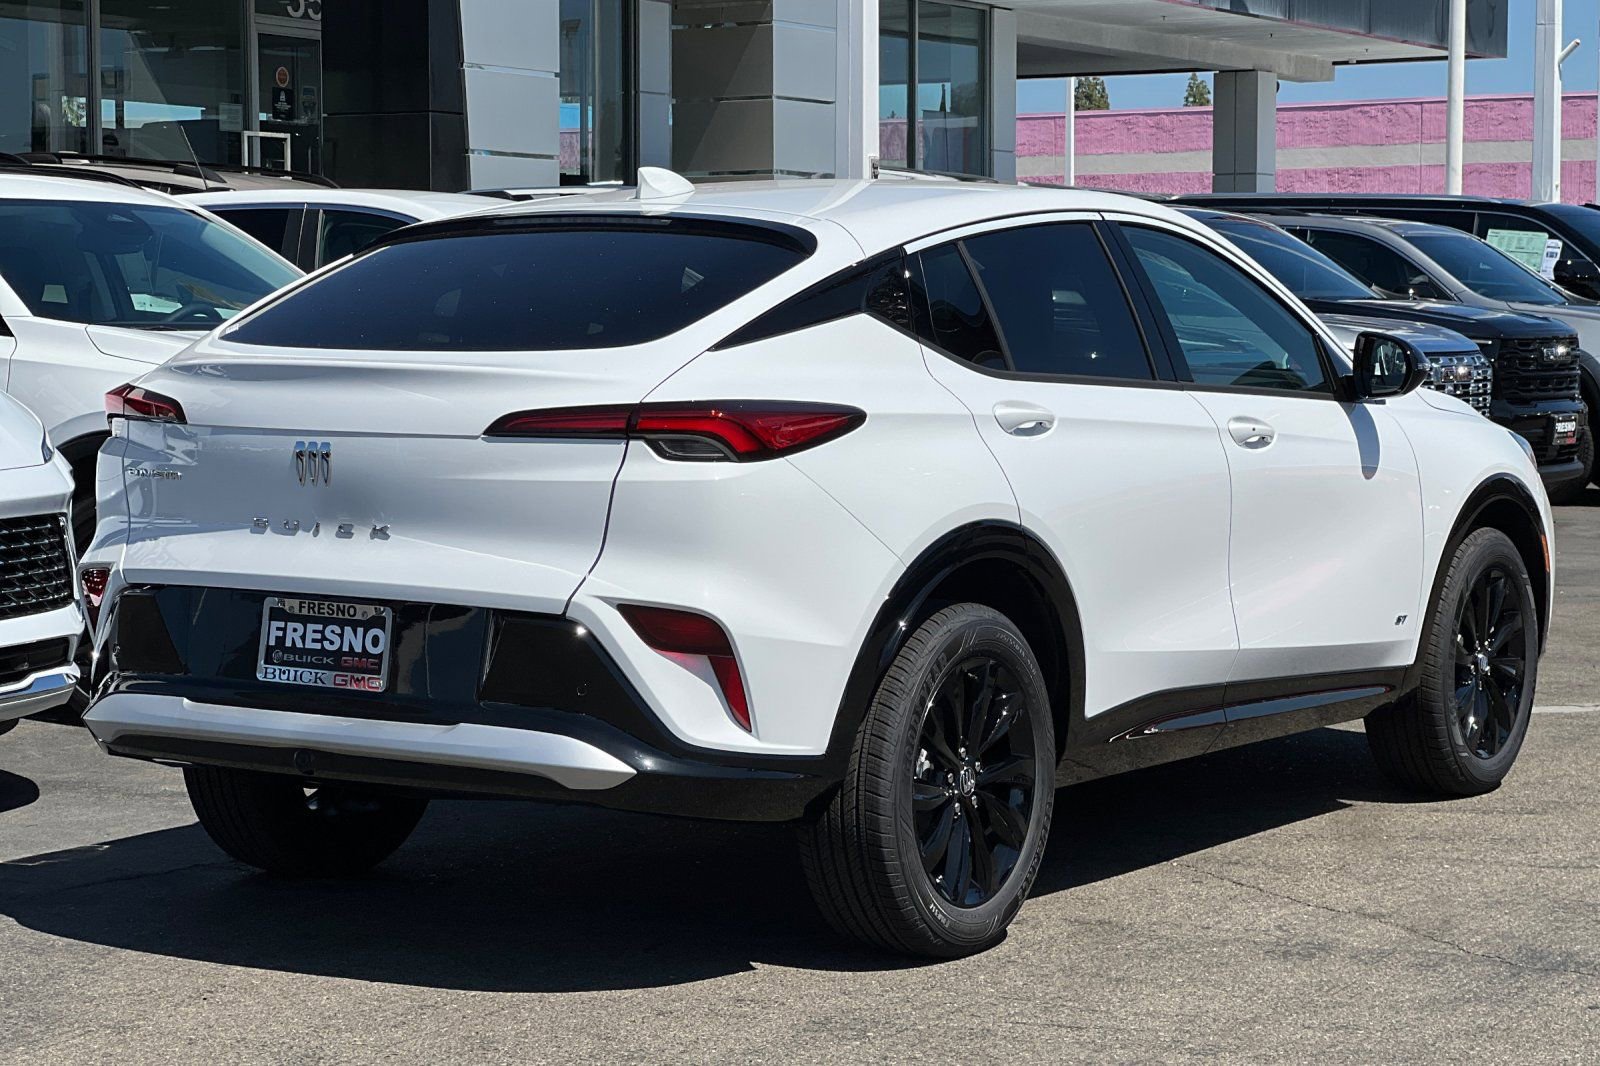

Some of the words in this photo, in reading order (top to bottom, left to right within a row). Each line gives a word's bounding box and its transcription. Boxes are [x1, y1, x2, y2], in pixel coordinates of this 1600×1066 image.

[250, 517, 391, 540] BUICK
[298, 601, 358, 618] FRESNO
[268, 620, 386, 655] FRESNO
[283, 653, 335, 665] BUICK
[340, 656, 380, 670] GMC
[262, 666, 328, 685] BUICK
[333, 673, 381, 691] GMC
